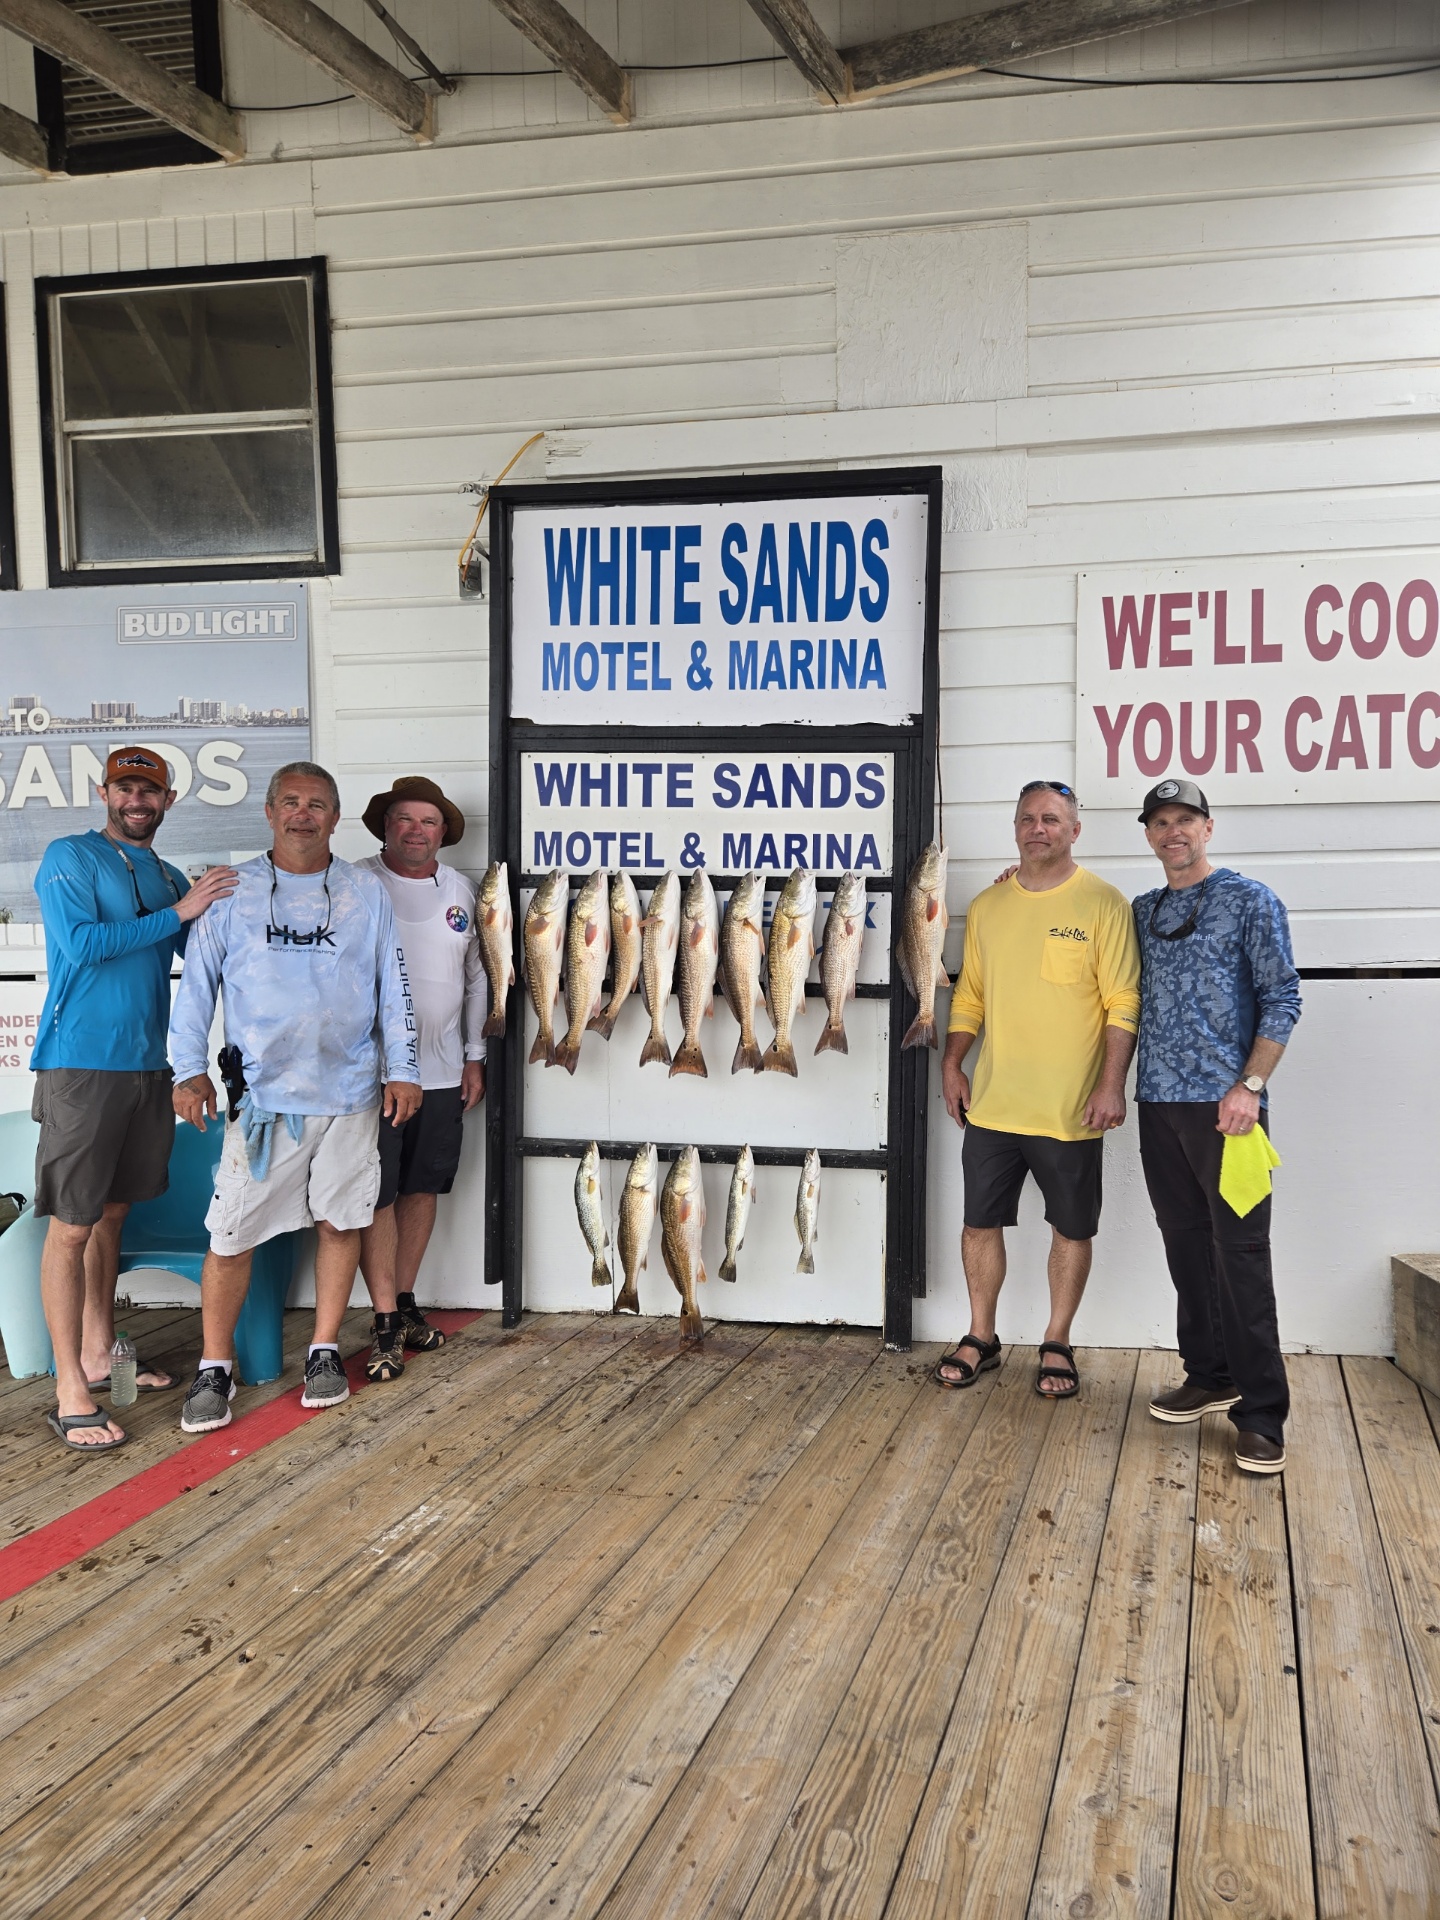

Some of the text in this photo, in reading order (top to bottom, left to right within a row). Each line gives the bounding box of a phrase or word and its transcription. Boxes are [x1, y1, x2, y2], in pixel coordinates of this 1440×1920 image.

[543, 519, 890, 626] WHITE SANDS
[124, 609, 290, 637] BUD LIGHT
[1102, 588, 1283, 670] WE'LL
[542, 638, 887, 691] MOTEL & MARINA
[8, 707, 50, 733] TO
[1093, 698, 1265, 778] YOUR
[0, 740, 248, 808] ANDS
[533, 762, 886, 809] WHITE SANDS
[533, 831, 882, 870] MOTEL & MARINA
